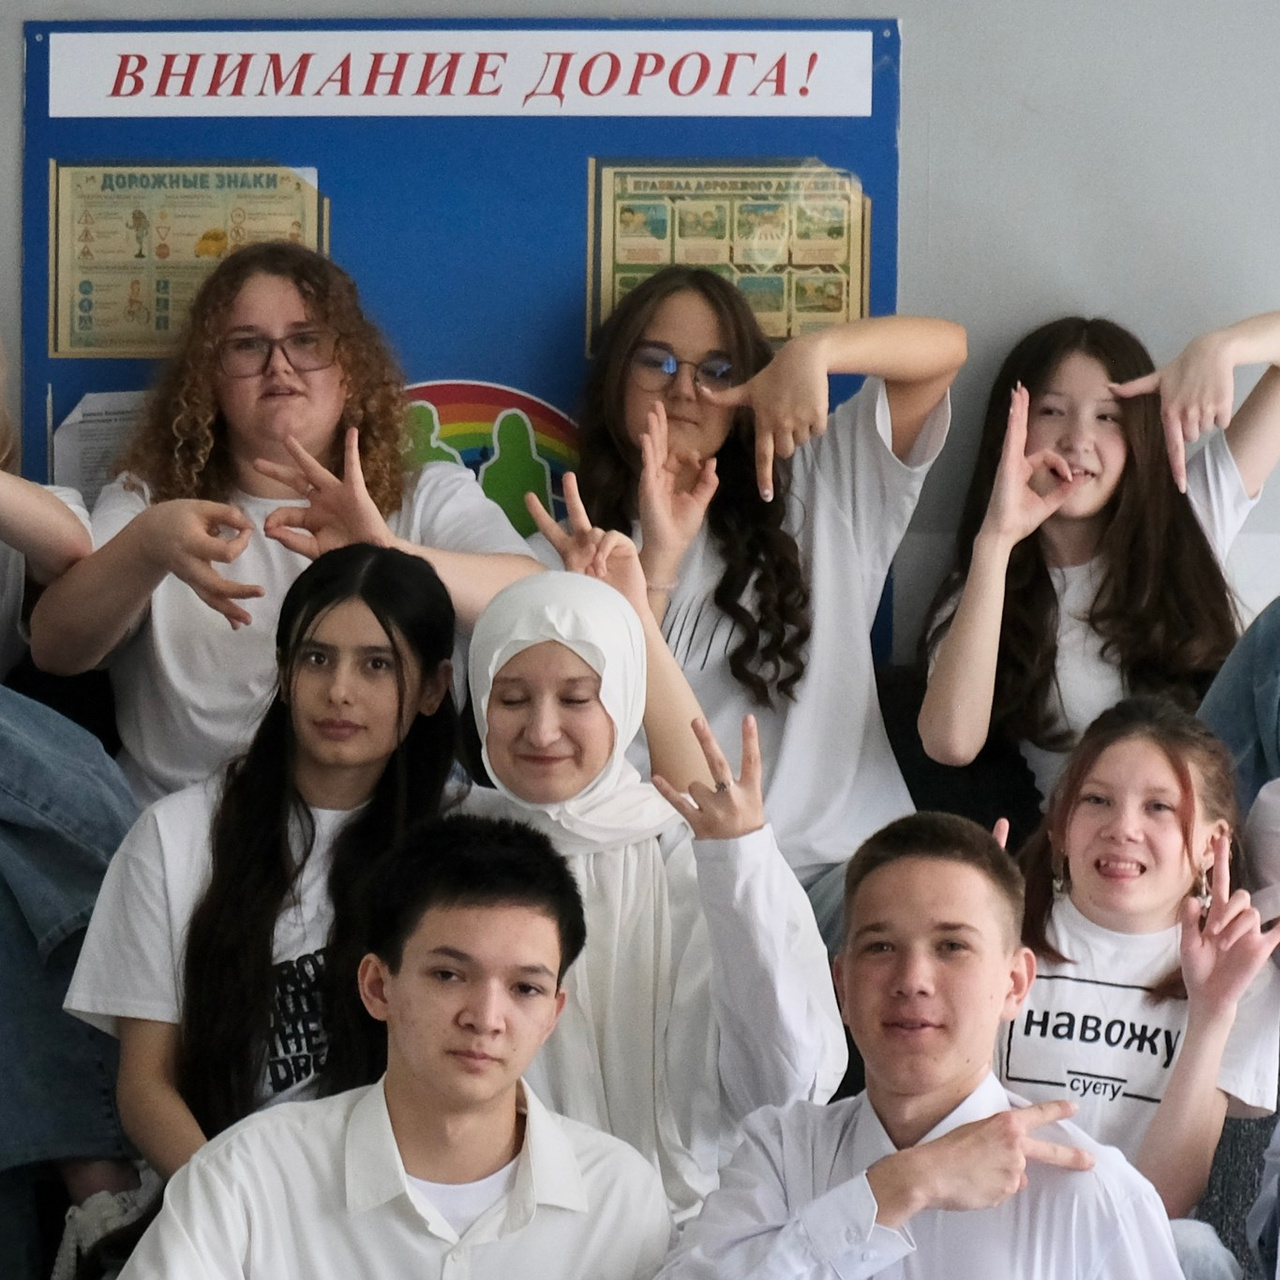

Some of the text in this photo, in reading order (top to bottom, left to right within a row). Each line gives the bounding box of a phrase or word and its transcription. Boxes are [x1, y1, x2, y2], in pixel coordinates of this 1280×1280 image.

[106, 51, 819, 108] ВНИМАНИЕ ДОРОГА!
[101, 173, 278, 192] ДОРОЖНЫЕ ЗНАКИ
[1023, 1009, 1181, 1069] навожу
[1069, 1078, 1123, 1102] суету
